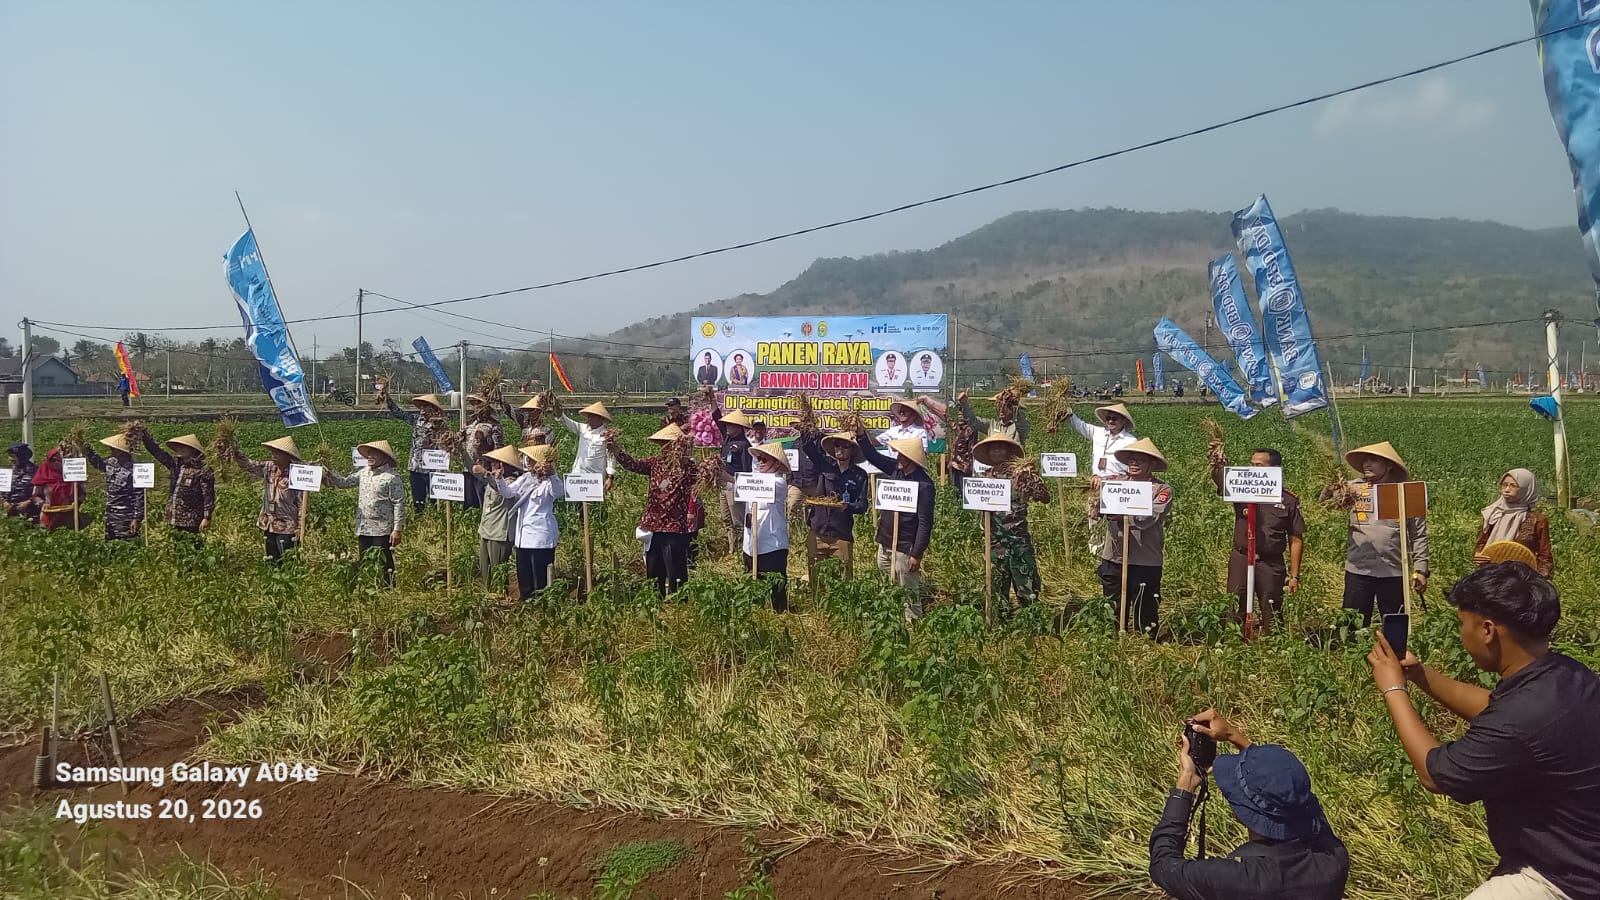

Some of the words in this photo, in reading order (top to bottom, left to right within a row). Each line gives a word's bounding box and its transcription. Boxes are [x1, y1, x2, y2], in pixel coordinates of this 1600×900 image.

[757, 341, 818, 365] PANEN
[822, 341, 872, 365] RAYA
[760, 372, 818, 388] BAWANG
[820, 372, 869, 389] MERAH
[725, 395, 737, 409] Di
[810, 397, 851, 411] Kretek,
[823, 415, 890, 429] Yoarta
[966, 482, 1005, 490] KOMANDAN
[1229, 478, 1277, 487] KEJAKSAAN
[883, 485, 911, 494] DIREKTUR
[1107, 487, 1141, 495] KAPOLDA
[1232, 486, 1259, 494] TINGGI
[881, 493, 901, 501] UTAMA
